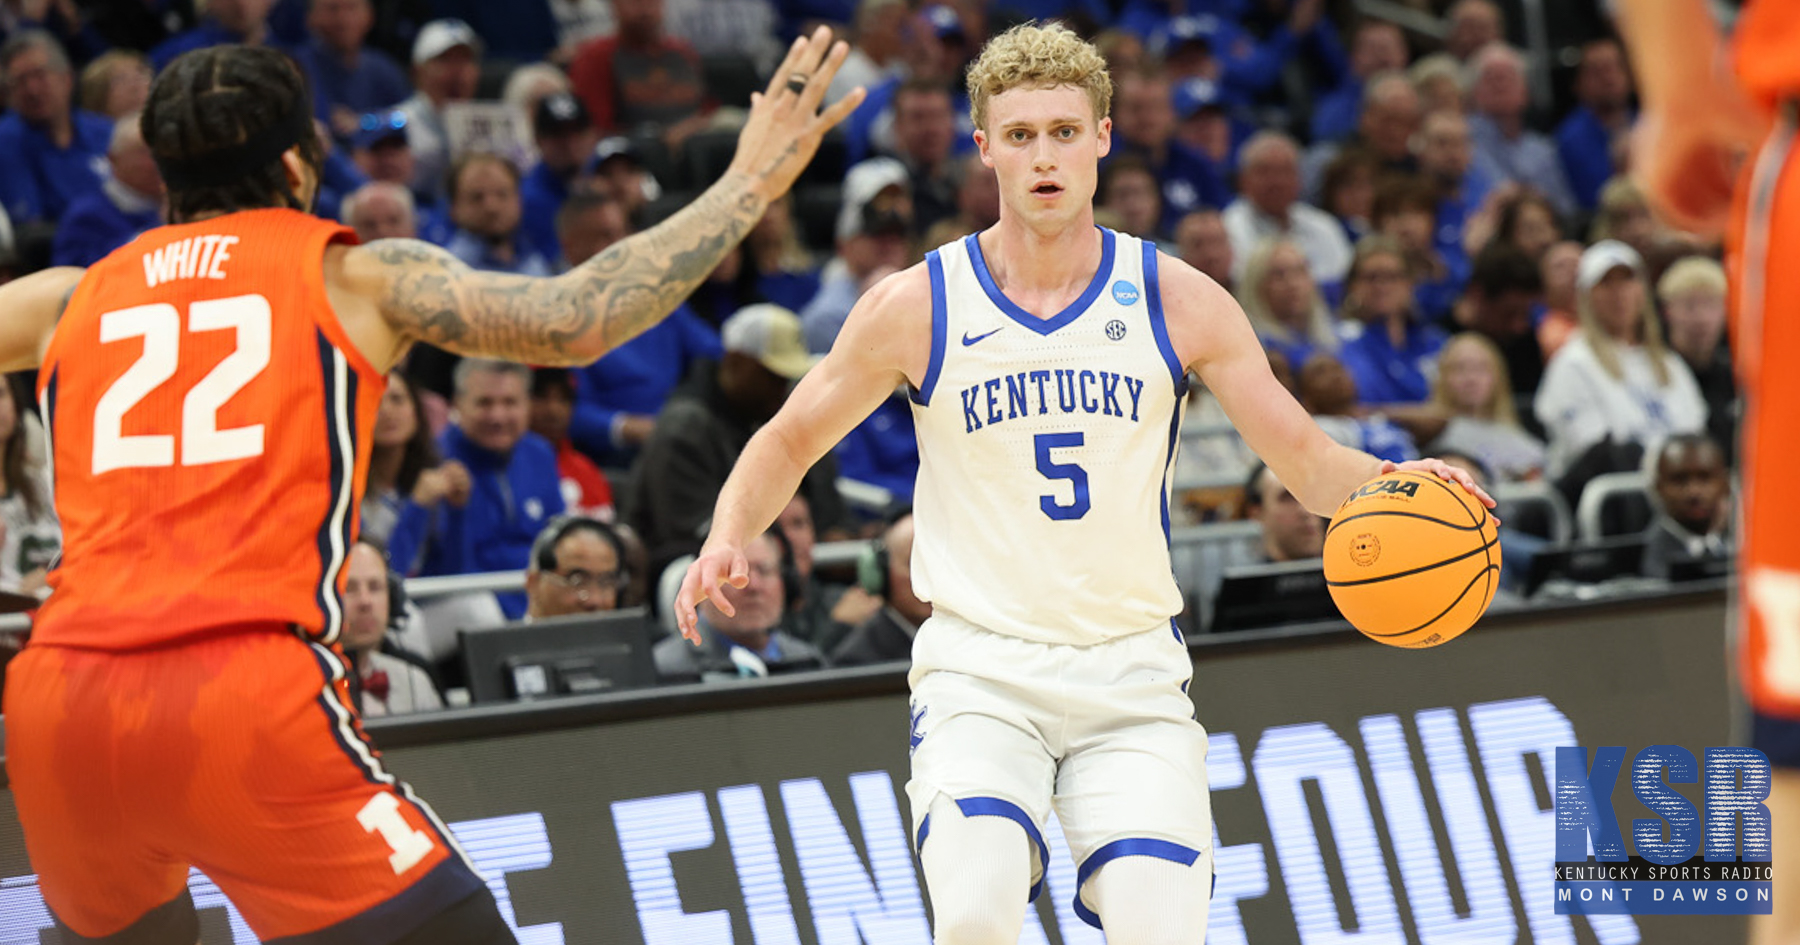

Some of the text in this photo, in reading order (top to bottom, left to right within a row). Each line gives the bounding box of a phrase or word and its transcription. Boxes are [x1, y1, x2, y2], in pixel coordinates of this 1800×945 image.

[143, 234, 239, 288] WHITE
[1105, 320, 1126, 340] SEC
[92, 293, 272, 476] 22
[961, 369, 1144, 433] KENTUCKY
[1033, 431, 1091, 521] 5
